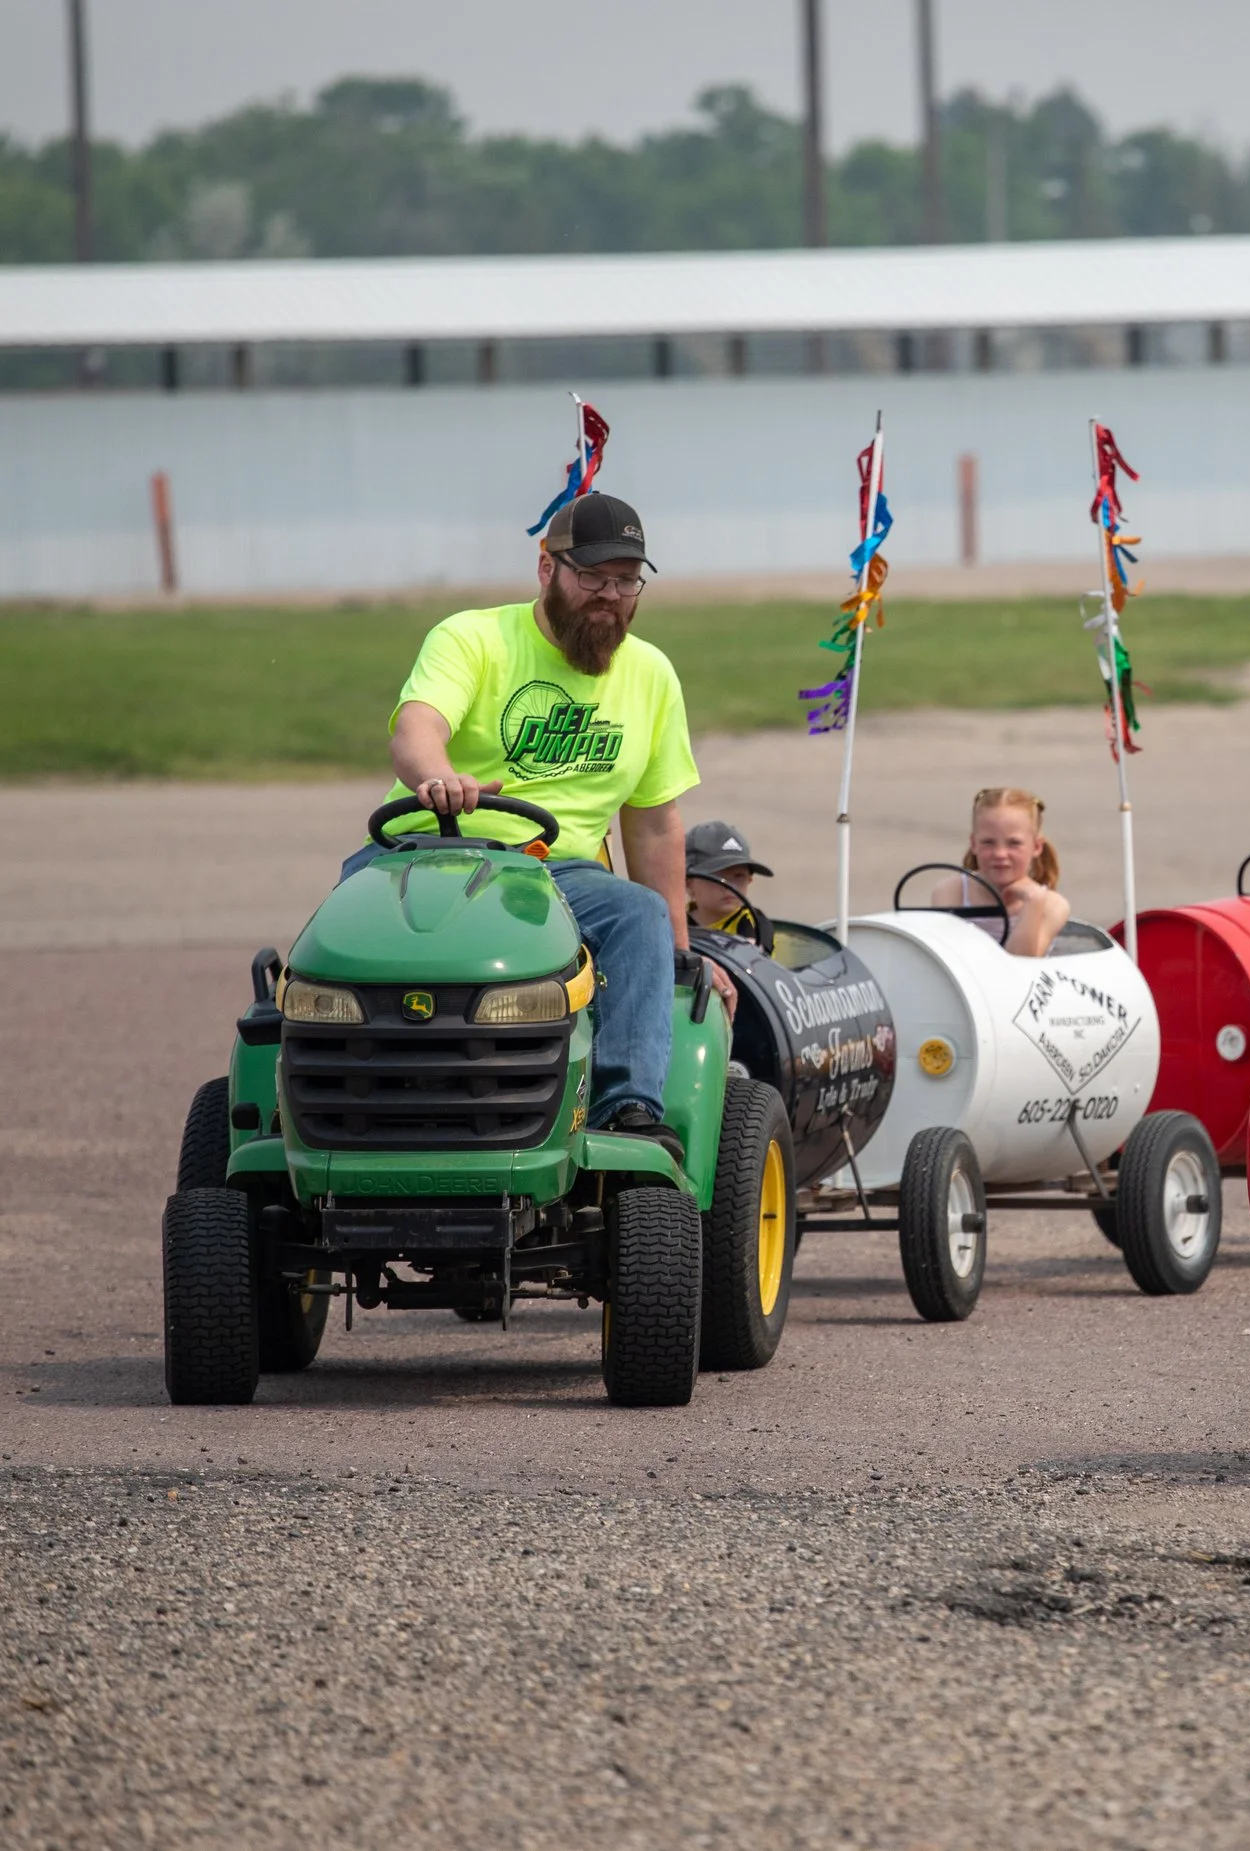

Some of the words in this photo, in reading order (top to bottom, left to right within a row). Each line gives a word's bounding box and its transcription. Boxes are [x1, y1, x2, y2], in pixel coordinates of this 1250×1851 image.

[547, 703, 600, 732] GET
[503, 716, 623, 763] PUMPED
[572, 763, 615, 773] ABERDEEN
[1028, 970, 1055, 1023] FARM
[828, 1027, 874, 1080] Farms
[343, 1177, 410, 1194] JOHN
[418, 1175, 498, 1194] DEERE
